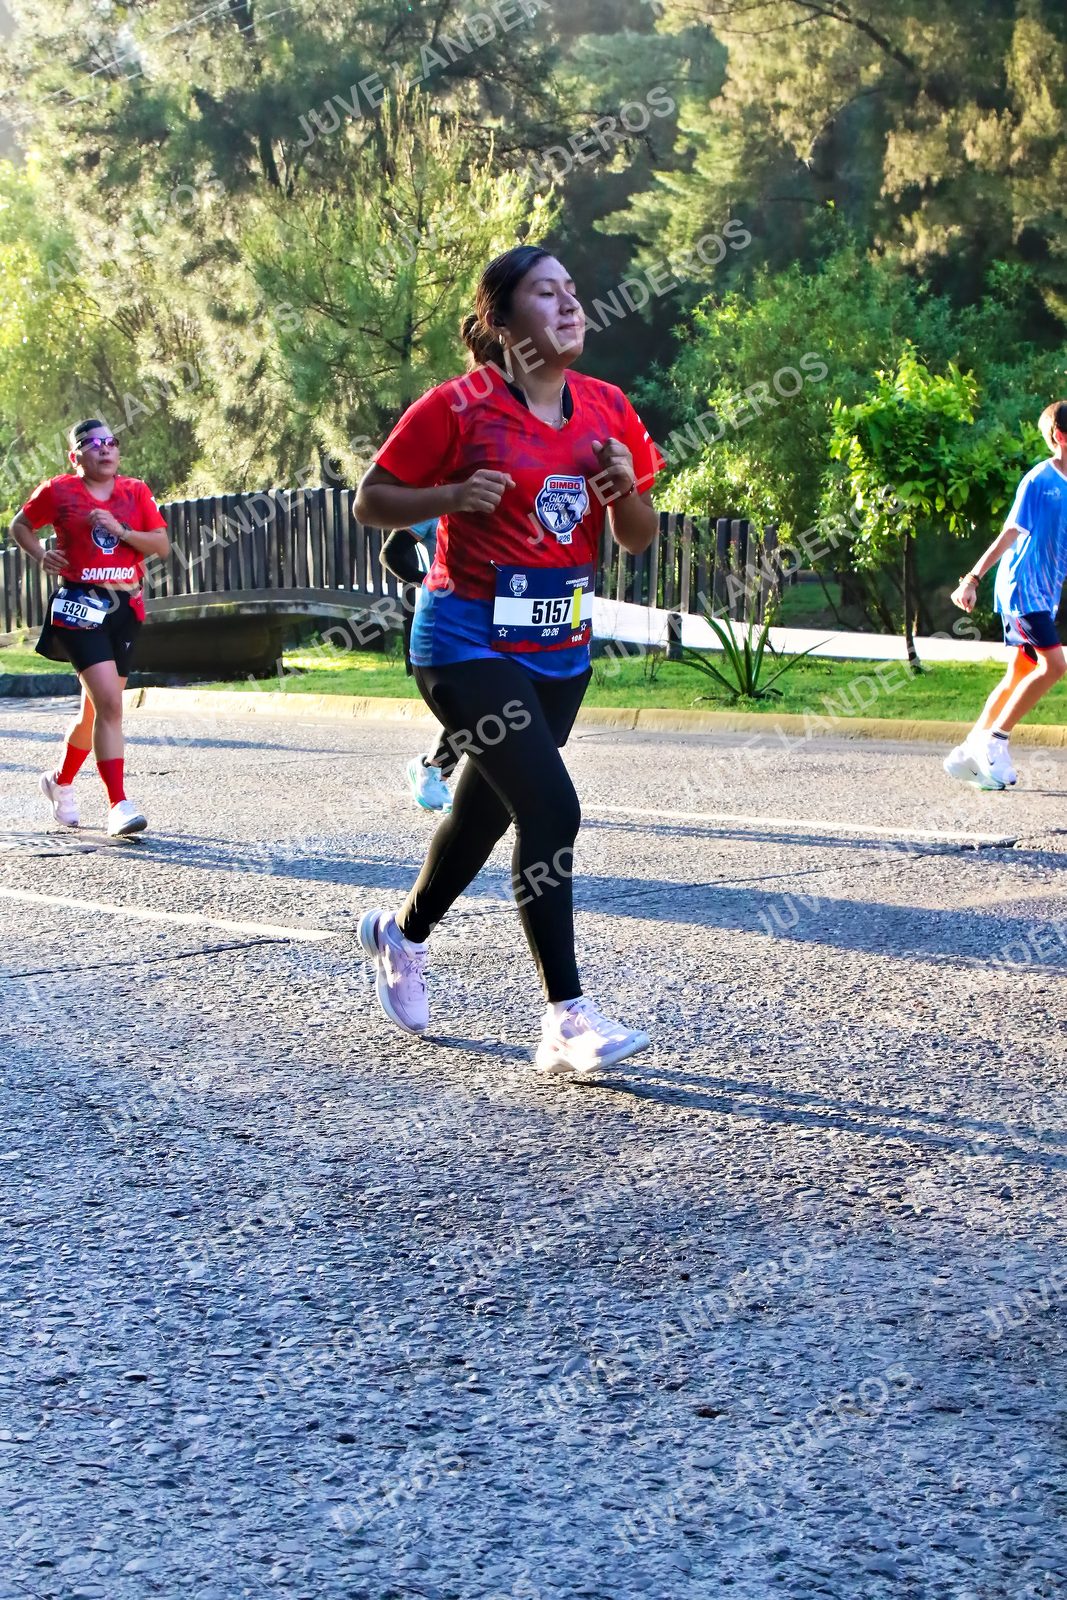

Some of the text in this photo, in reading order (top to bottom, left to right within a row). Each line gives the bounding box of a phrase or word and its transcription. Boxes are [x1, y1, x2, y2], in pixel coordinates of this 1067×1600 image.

[549, 481, 580, 490] BIMBO
[548, 492, 579, 505] Global
[542, 501, 566, 512] Race
[80, 567, 135, 581] SANTIAGO
[61, 601, 89, 619] 5420
[531, 598, 572, 625] 5157
[571, 633, 583, 643] 10K
